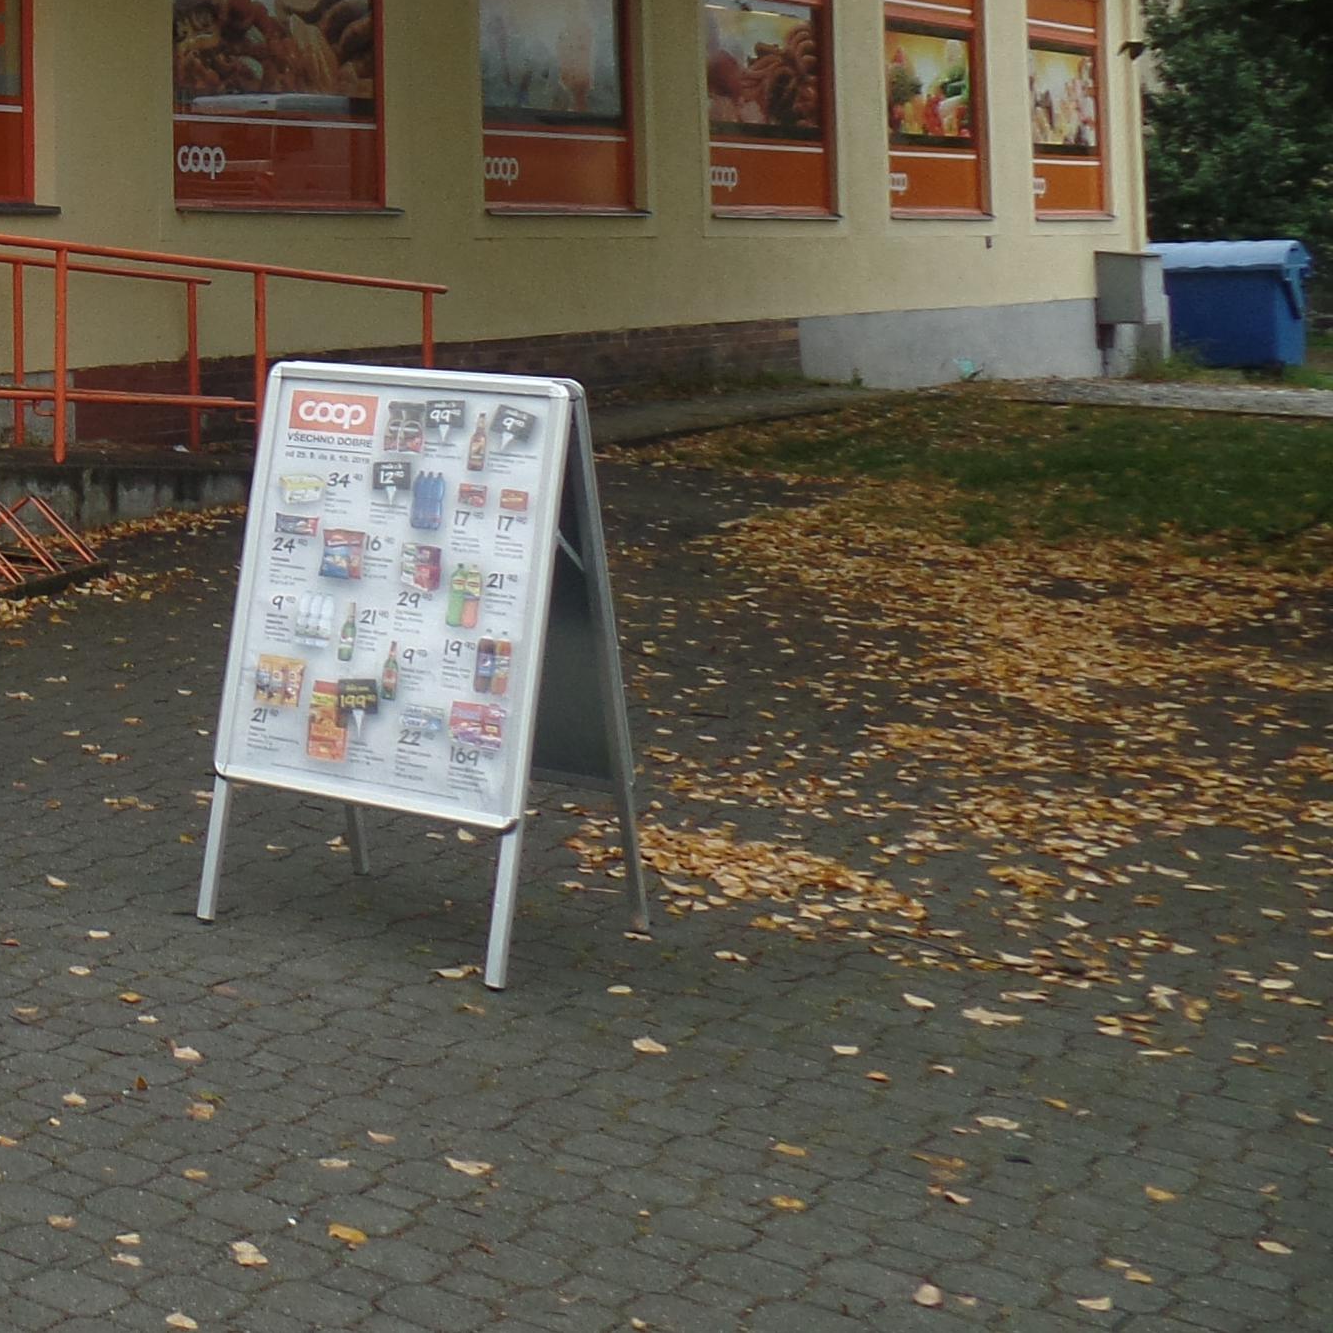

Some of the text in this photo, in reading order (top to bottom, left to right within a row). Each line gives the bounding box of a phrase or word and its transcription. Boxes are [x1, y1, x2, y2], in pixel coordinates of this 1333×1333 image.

[177, 145, 226, 180] coop
[298, 400, 367, 429] coop
[288, 431, 335, 445] VŠECHNO
